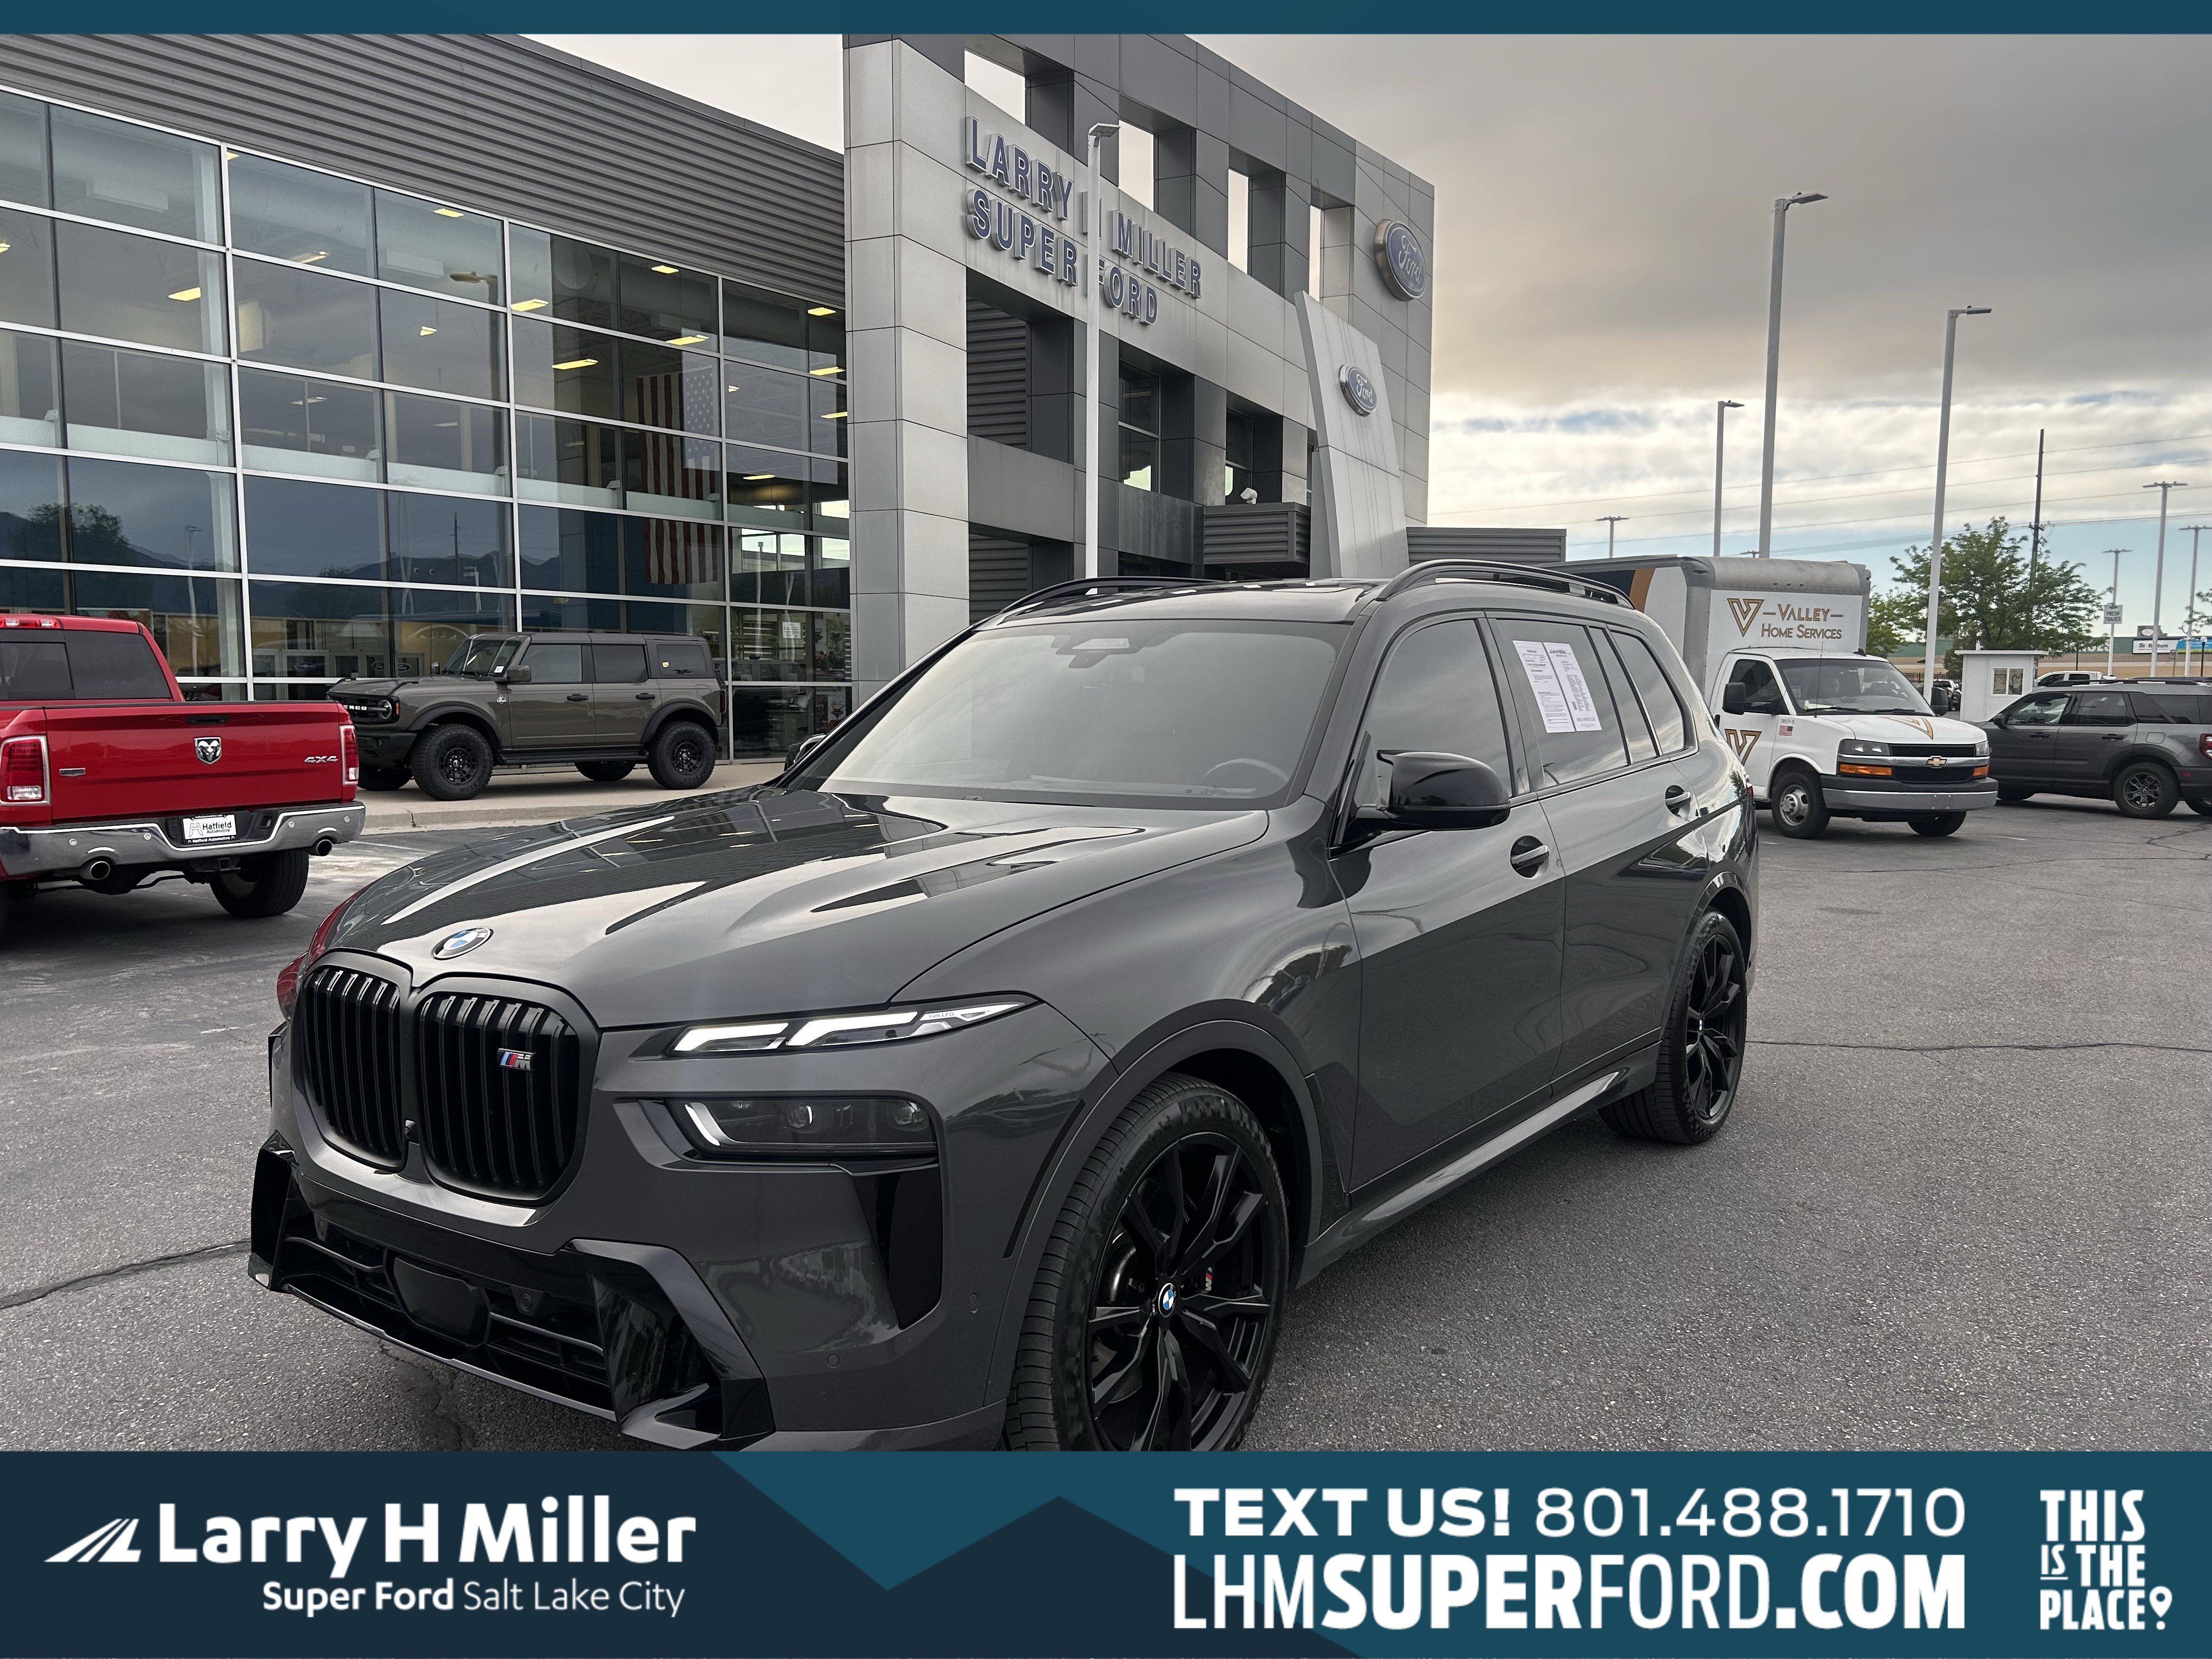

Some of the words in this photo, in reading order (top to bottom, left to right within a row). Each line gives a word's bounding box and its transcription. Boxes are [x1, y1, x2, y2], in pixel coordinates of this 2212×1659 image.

[967, 116, 1073, 221] LARRY
[1112, 210, 1201, 298] MILLER
[967, 188, 1078, 287] SUPER
[1398, 234, 1423, 284] Ford
[1357, 373, 1374, 405] Ford
[1778, 604, 1830, 622] VALLEY
[1761, 623, 1793, 637] HOME
[1796, 624, 1842, 639] SERVICES
[202, 821, 232, 830] Hatfield
